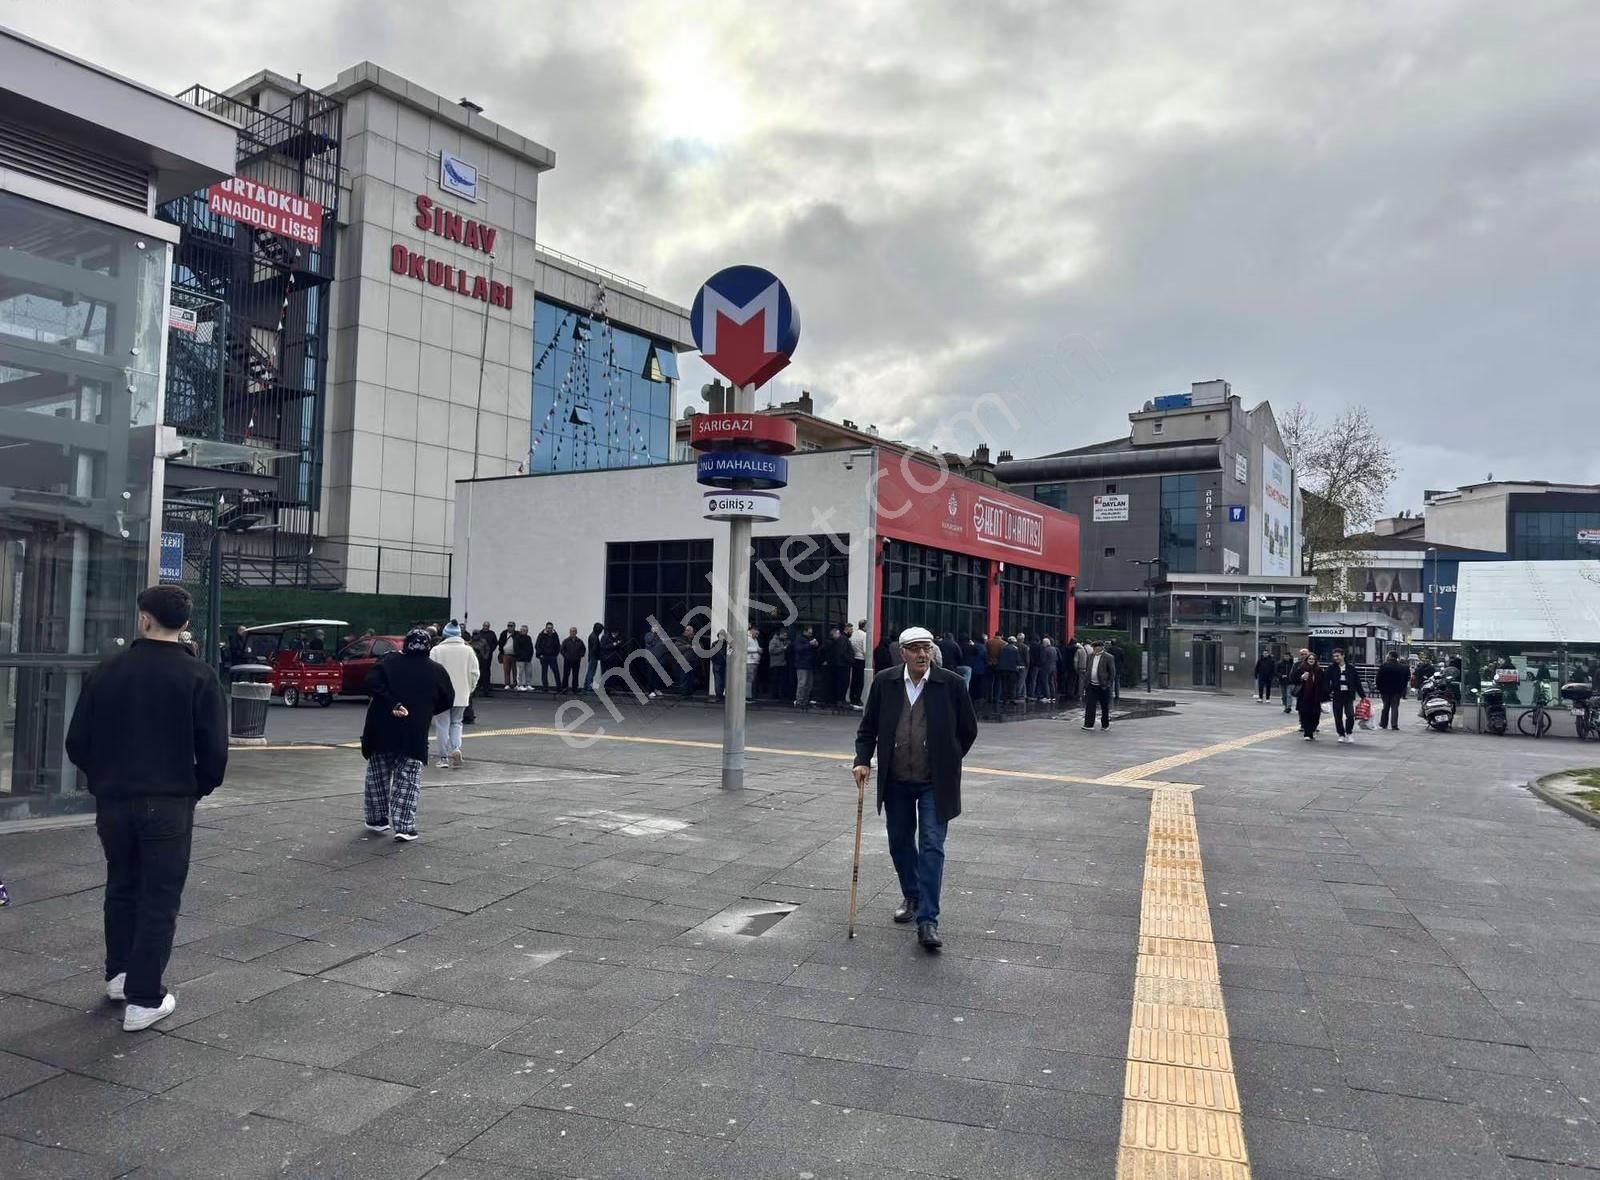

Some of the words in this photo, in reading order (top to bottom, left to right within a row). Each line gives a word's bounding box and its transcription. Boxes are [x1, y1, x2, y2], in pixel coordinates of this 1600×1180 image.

[211, 194, 277, 229] ANADOLU
[281, 218, 319, 243] LİSESİ
[415, 194, 497, 254] SINAV
[391, 243, 513, 310] OKULLARI
[699, 418, 753, 433] SARIGAZİ
[719, 498, 745, 511] GİRİŞ
[747, 500, 754, 510] 2
